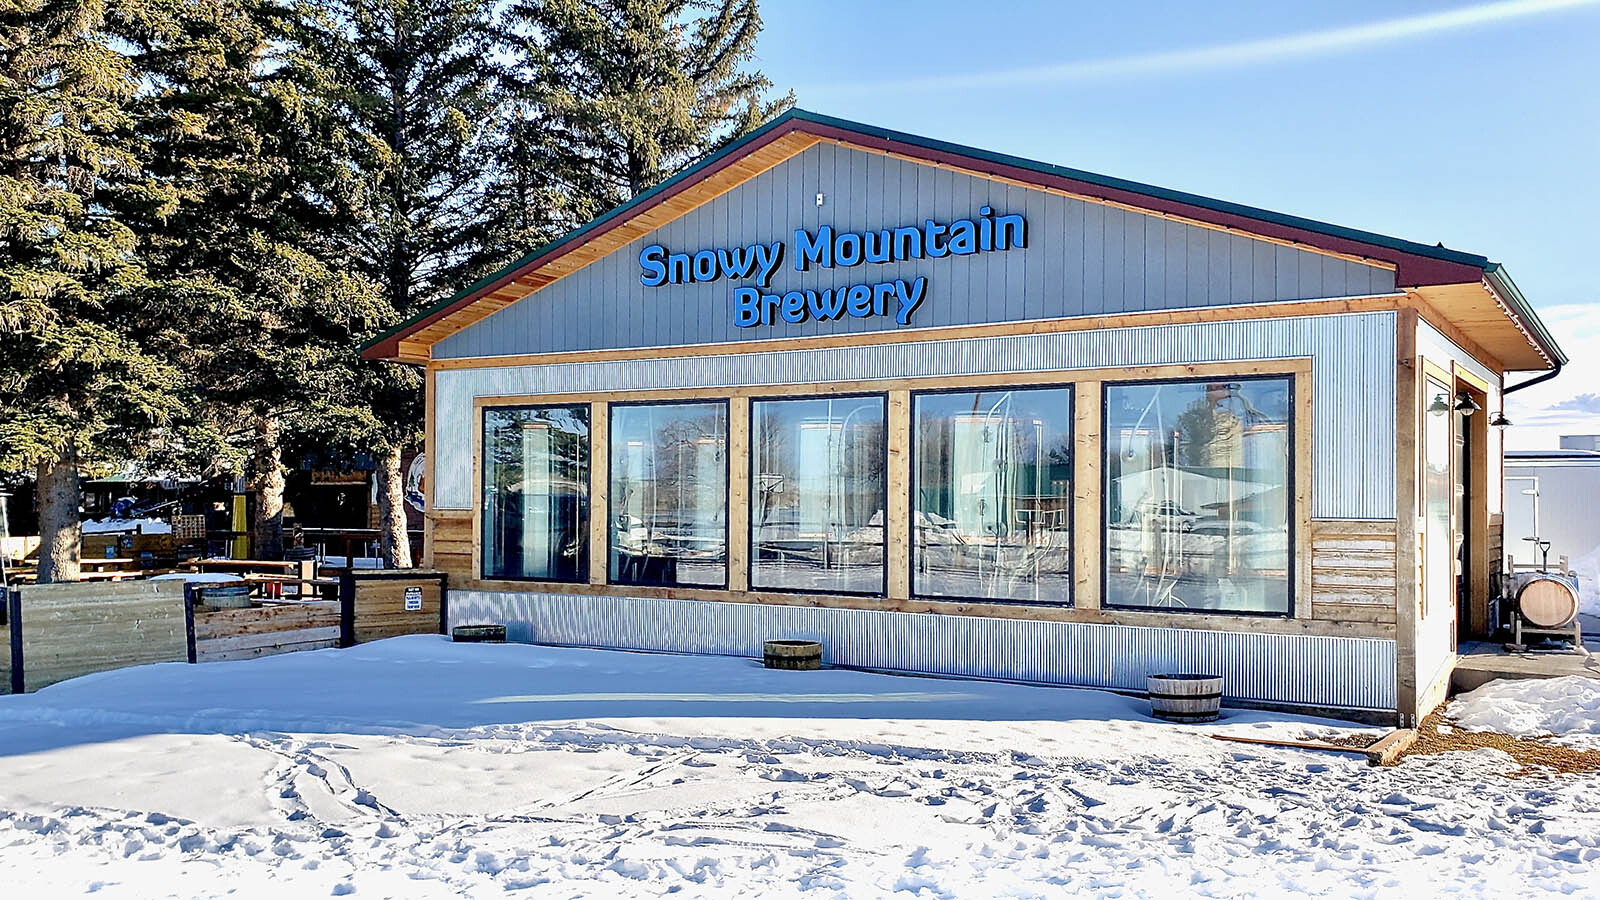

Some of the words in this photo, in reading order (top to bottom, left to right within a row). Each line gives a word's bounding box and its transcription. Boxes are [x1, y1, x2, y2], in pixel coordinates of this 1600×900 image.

[640, 242, 784, 287] Snowy
[794, 206, 1027, 271] Mountain
[734, 277, 927, 328] Brewery
